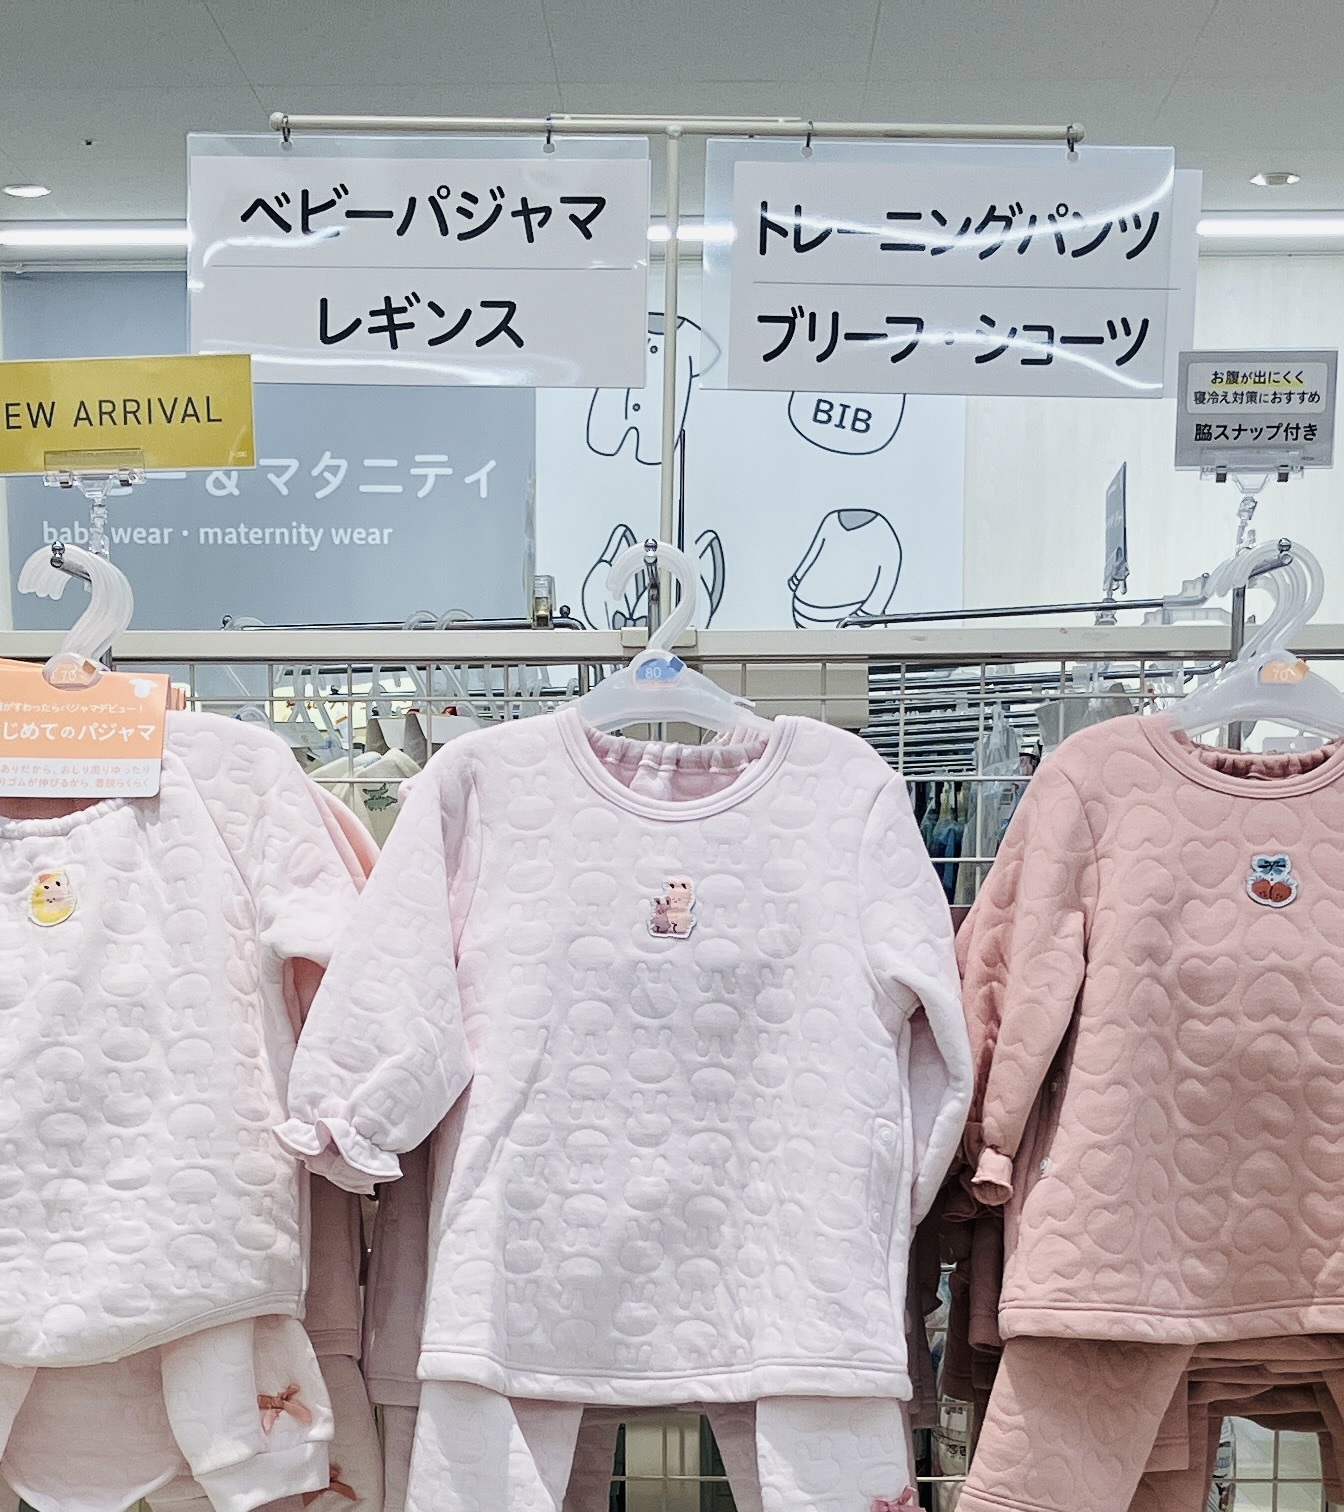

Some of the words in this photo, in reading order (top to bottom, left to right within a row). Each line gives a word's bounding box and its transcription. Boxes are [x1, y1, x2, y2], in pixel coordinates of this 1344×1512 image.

[240, 183, 607, 243] ベビーパジャマ
[759, 201, 1160, 260] トレーニングパンツ
[319, 291, 524, 350] レギンス
[757, 305, 1150, 366] ブリーフ・ショーツ
[1210, 370, 1304, 385] お腹が出にくく
[73, 396, 223, 428] ARRIVAL
[1194, 391, 1321, 405] 寝冷え対策におすすめ
[812, 398, 872, 434] BIB
[1194, 422, 1318, 442] 脇スナップ付き
[257, 451, 497, 500] マタニティ
[41, 520, 102, 547] bab
[111, 525, 174, 545] wear
[199, 521, 325, 552] maternity
[330, 526, 393, 545] wear
[645, 667, 662, 678] 80
